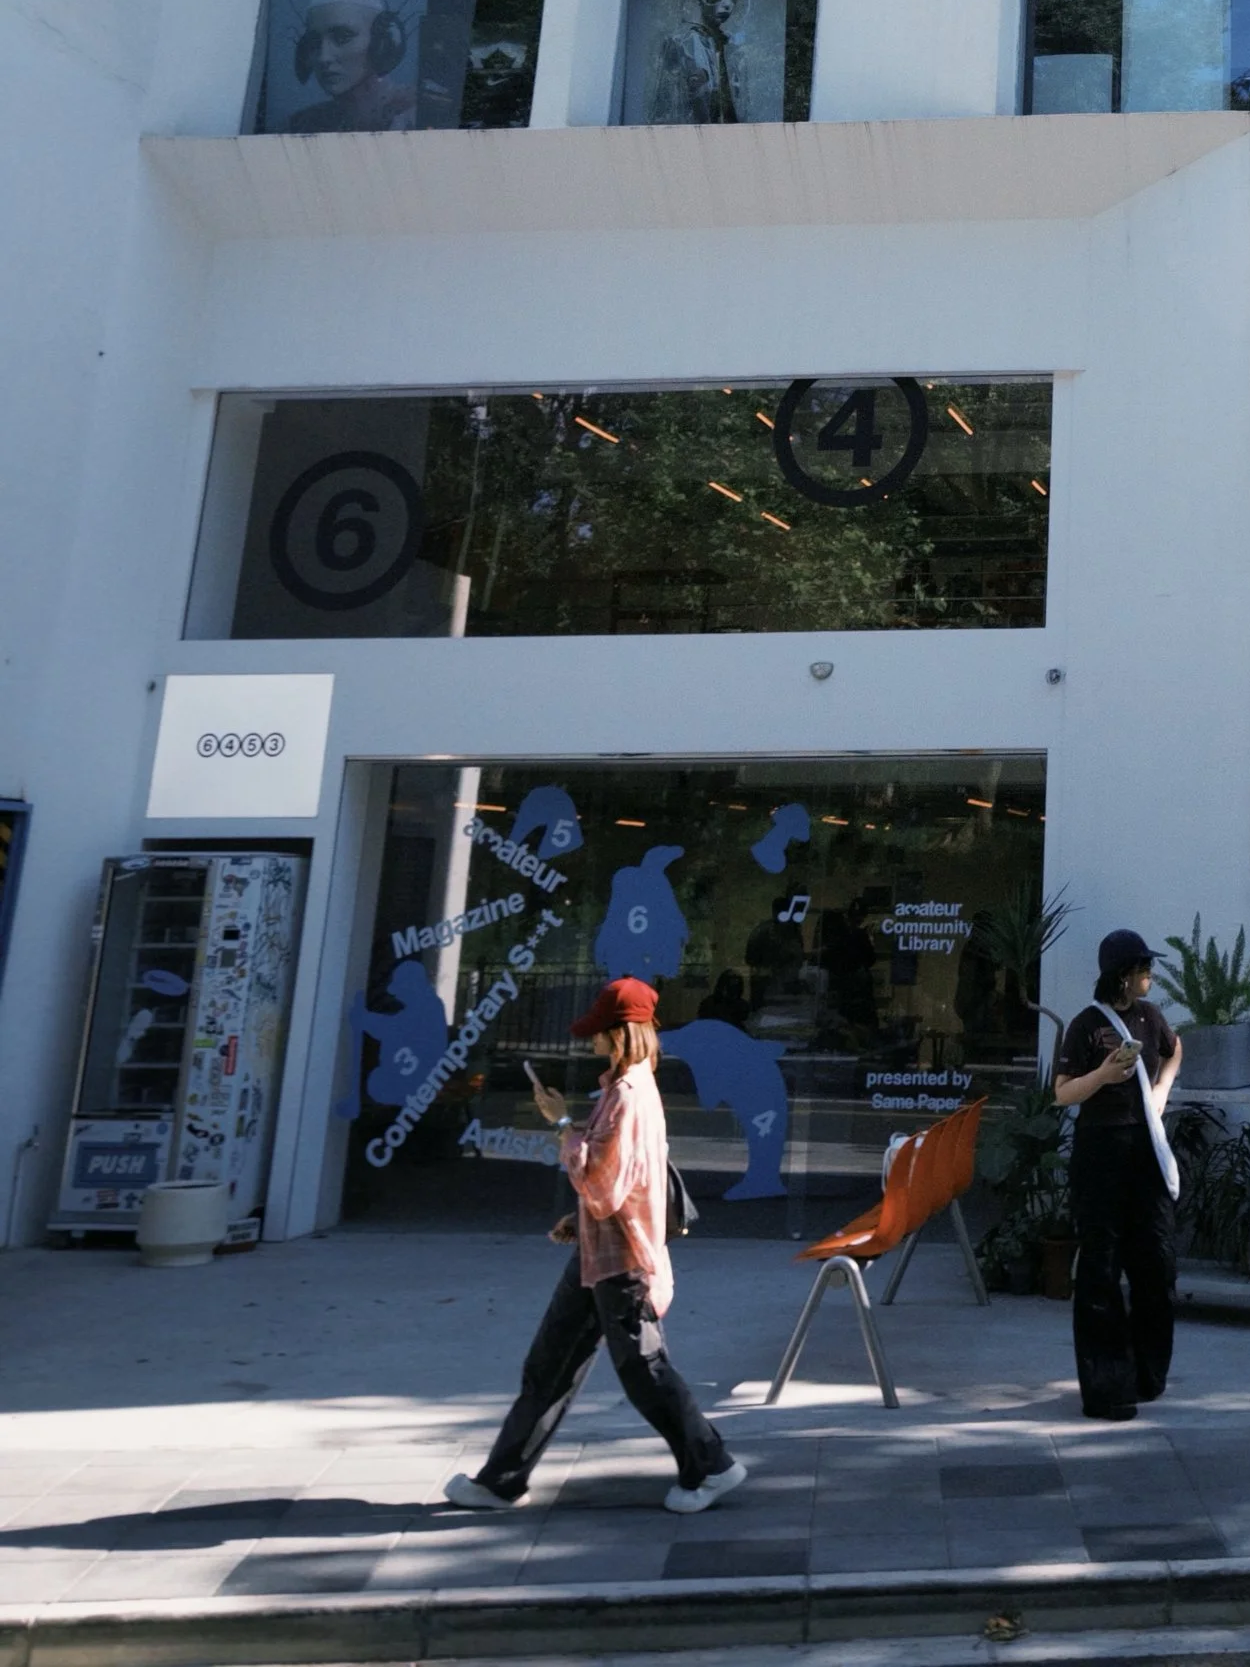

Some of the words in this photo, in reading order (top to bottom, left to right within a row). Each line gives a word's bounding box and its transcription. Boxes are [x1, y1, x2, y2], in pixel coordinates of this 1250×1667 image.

[817, 389, 883, 468] 4
[314, 489, 381, 572] 6
[197, 733, 286, 757] 6453
[551, 818, 572, 848] 5
[391, 892, 526, 960] Magazine
[627, 905, 649, 934] 6
[881, 918, 973, 939] Community
[898, 935, 955, 955] Library
[364, 968, 519, 1168] Contemporary
[394, 1046, 419, 1076] 3
[866, 1071, 948, 1088] presented
[951, 1071, 973, 1091] by
[871, 1093, 914, 1109] Same
[752, 1110, 778, 1138] 4
[87, 1155, 147, 1175] PUSH
